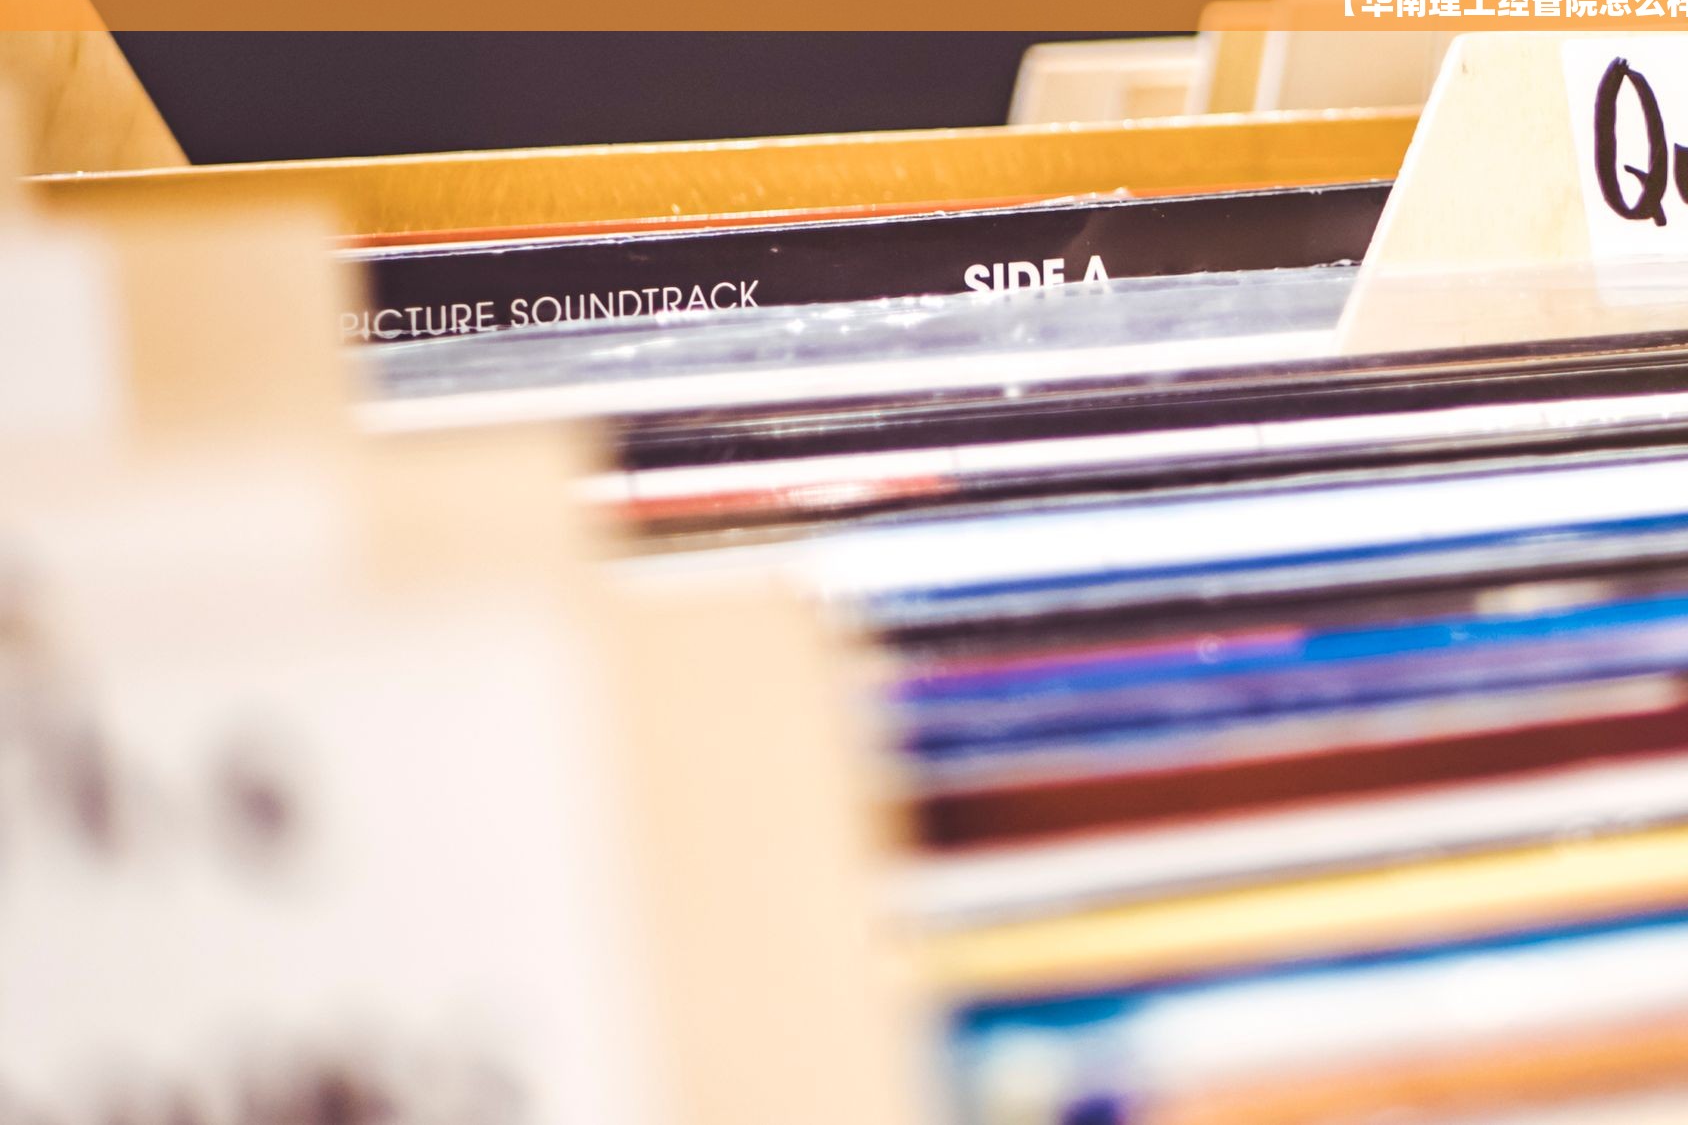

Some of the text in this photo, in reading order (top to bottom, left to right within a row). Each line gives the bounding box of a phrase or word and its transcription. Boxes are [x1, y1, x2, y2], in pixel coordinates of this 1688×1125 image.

[963, 254, 1111, 295] SIDE A
[341, 279, 760, 342] PICTURE SOUNDTRACK
